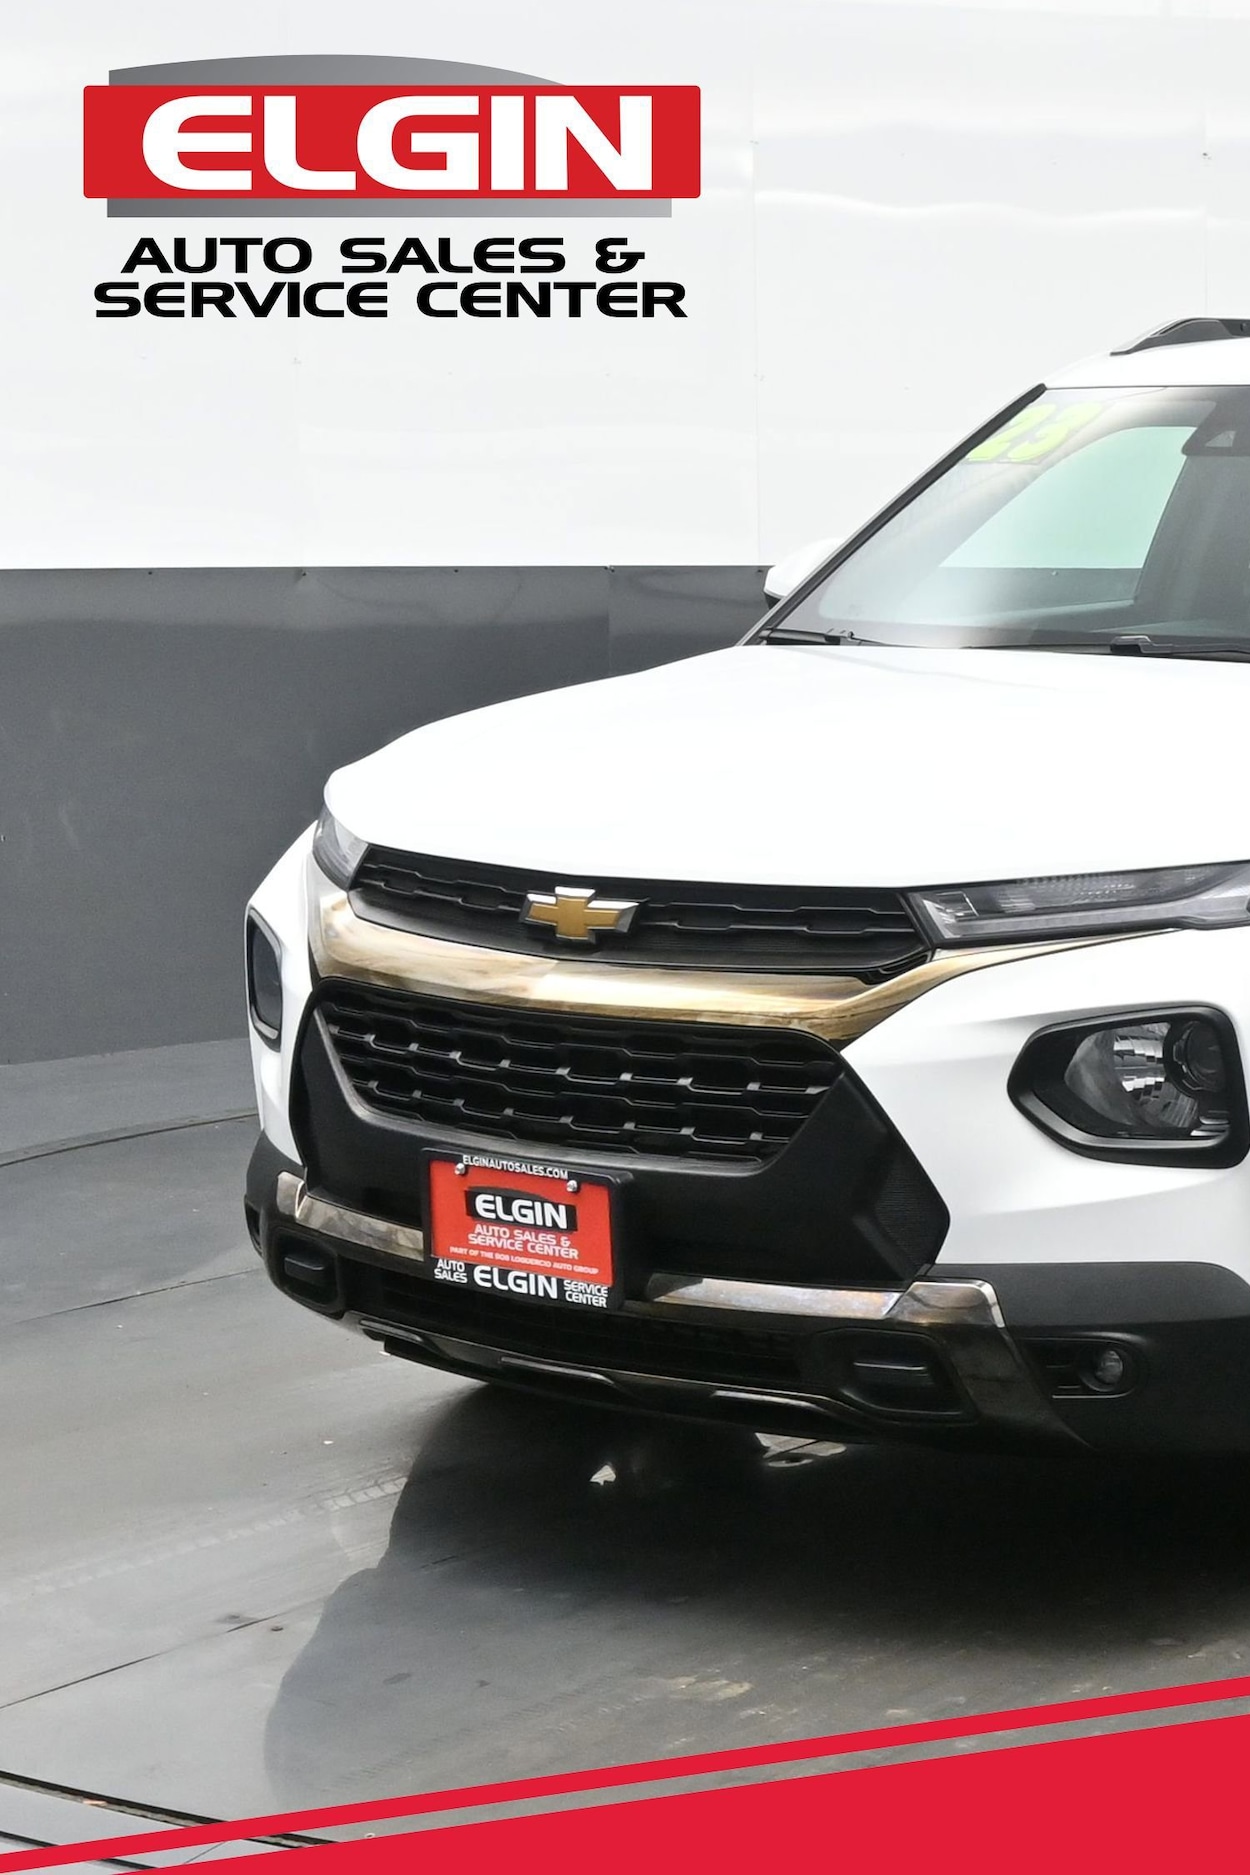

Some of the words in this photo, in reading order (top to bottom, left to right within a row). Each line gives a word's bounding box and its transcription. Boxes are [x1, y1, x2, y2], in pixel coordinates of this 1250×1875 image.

[965, 403, 1101, 462] 23
[462, 1155, 568, 1179] ELGINAUTOSALES.COM
[475, 1194, 567, 1229] ELGIN
[468, 1234, 523, 1251] SERVICE
[527, 1243, 579, 1259] CENTER
[474, 1224, 510, 1239] AUTO
[514, 1230, 556, 1245] SALES
[560, 1236, 570, 1246] &
[434, 1269, 468, 1283] SALES
[437, 1259, 465, 1272] AUTO
[473, 1265, 558, 1299] ELGIN
[563, 1281, 608, 1297] SERVICE
[565, 1291, 607, 1308] CENTER
